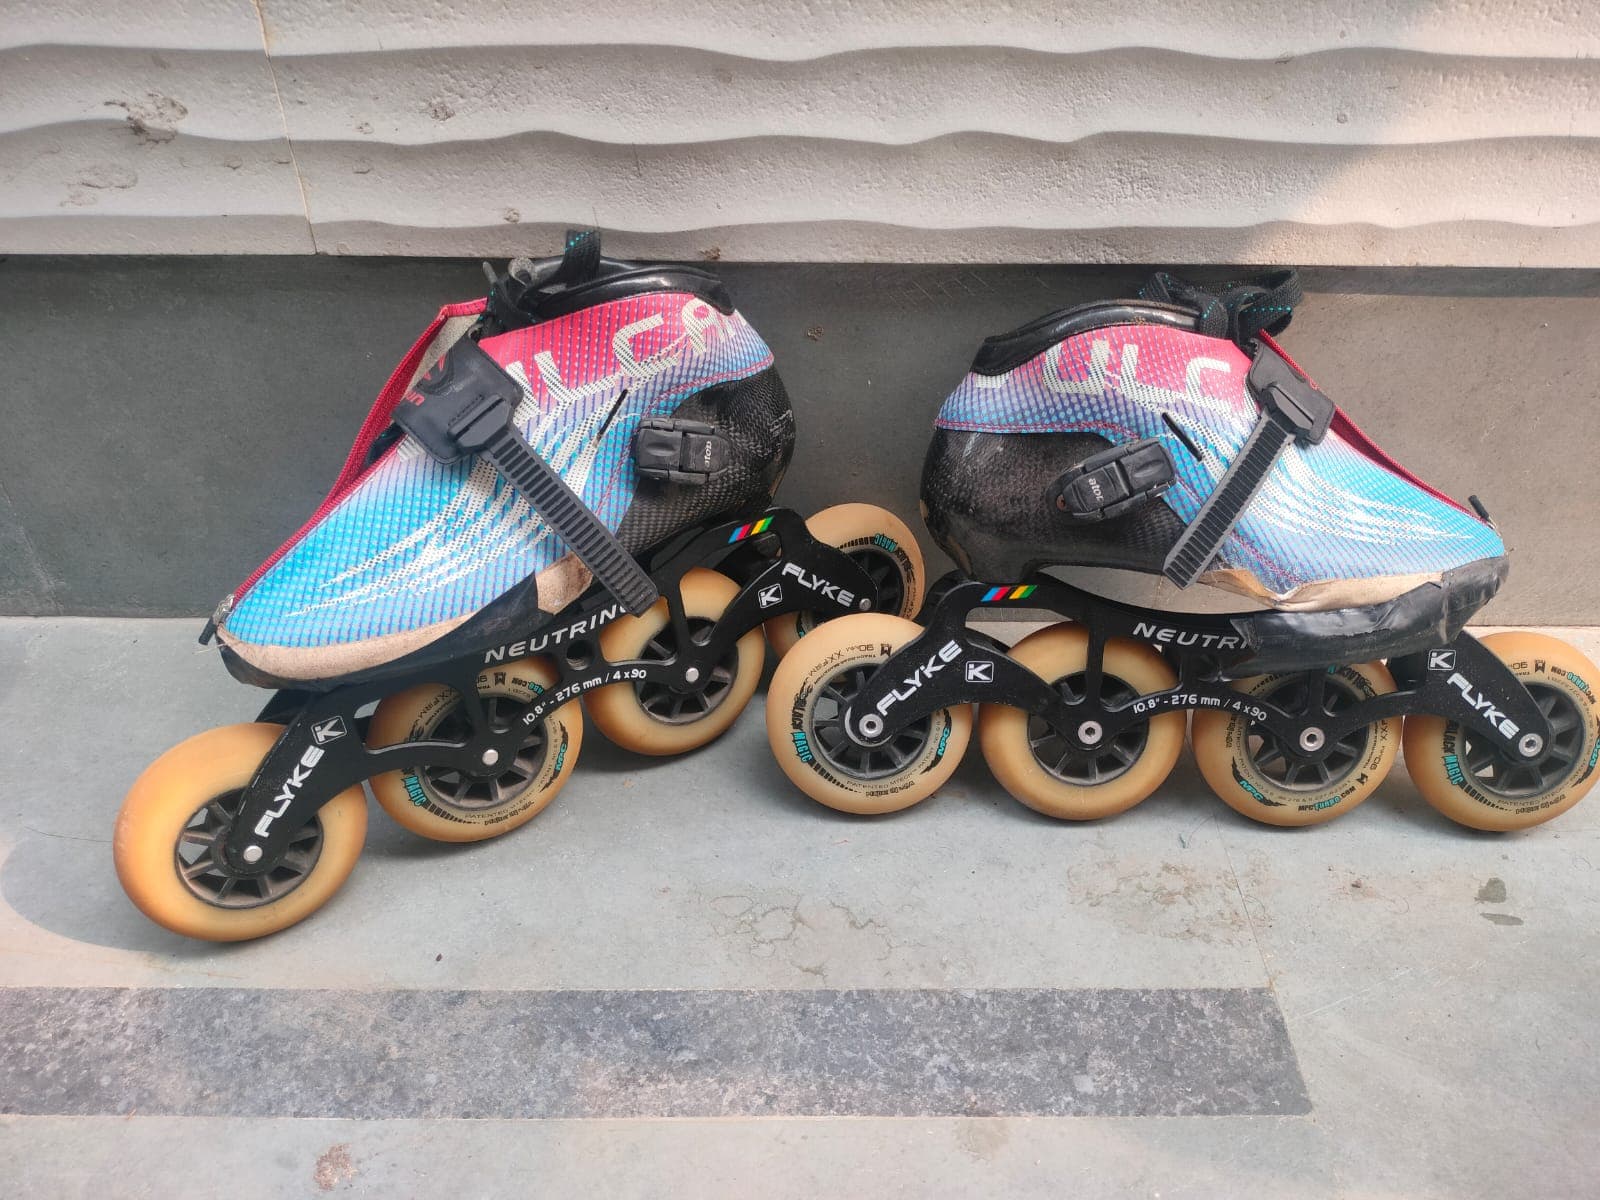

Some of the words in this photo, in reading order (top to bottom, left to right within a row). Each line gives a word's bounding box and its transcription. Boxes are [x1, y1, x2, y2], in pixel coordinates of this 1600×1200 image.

[874, 533, 898, 553] MAGIC
[781, 562, 855, 608] FLYKE
[555, 683, 581, 702] 276
[582, 677, 602, 690] mm
[876, 639, 962, 717] FLYKE
[1171, 694, 1198, 705] 276
[1200, 696, 1221, 706] mm
[1446, 672, 1521, 740] FLYKE
[792, 731, 815, 763] MAGIC
[936, 727, 951, 757] MPC
[1443, 754, 1464, 785] MAGIC
[254, 744, 326, 838] FLYKE
[402, 775, 428, 807] MAGIC
[1239, 779, 1265, 801] MPC
